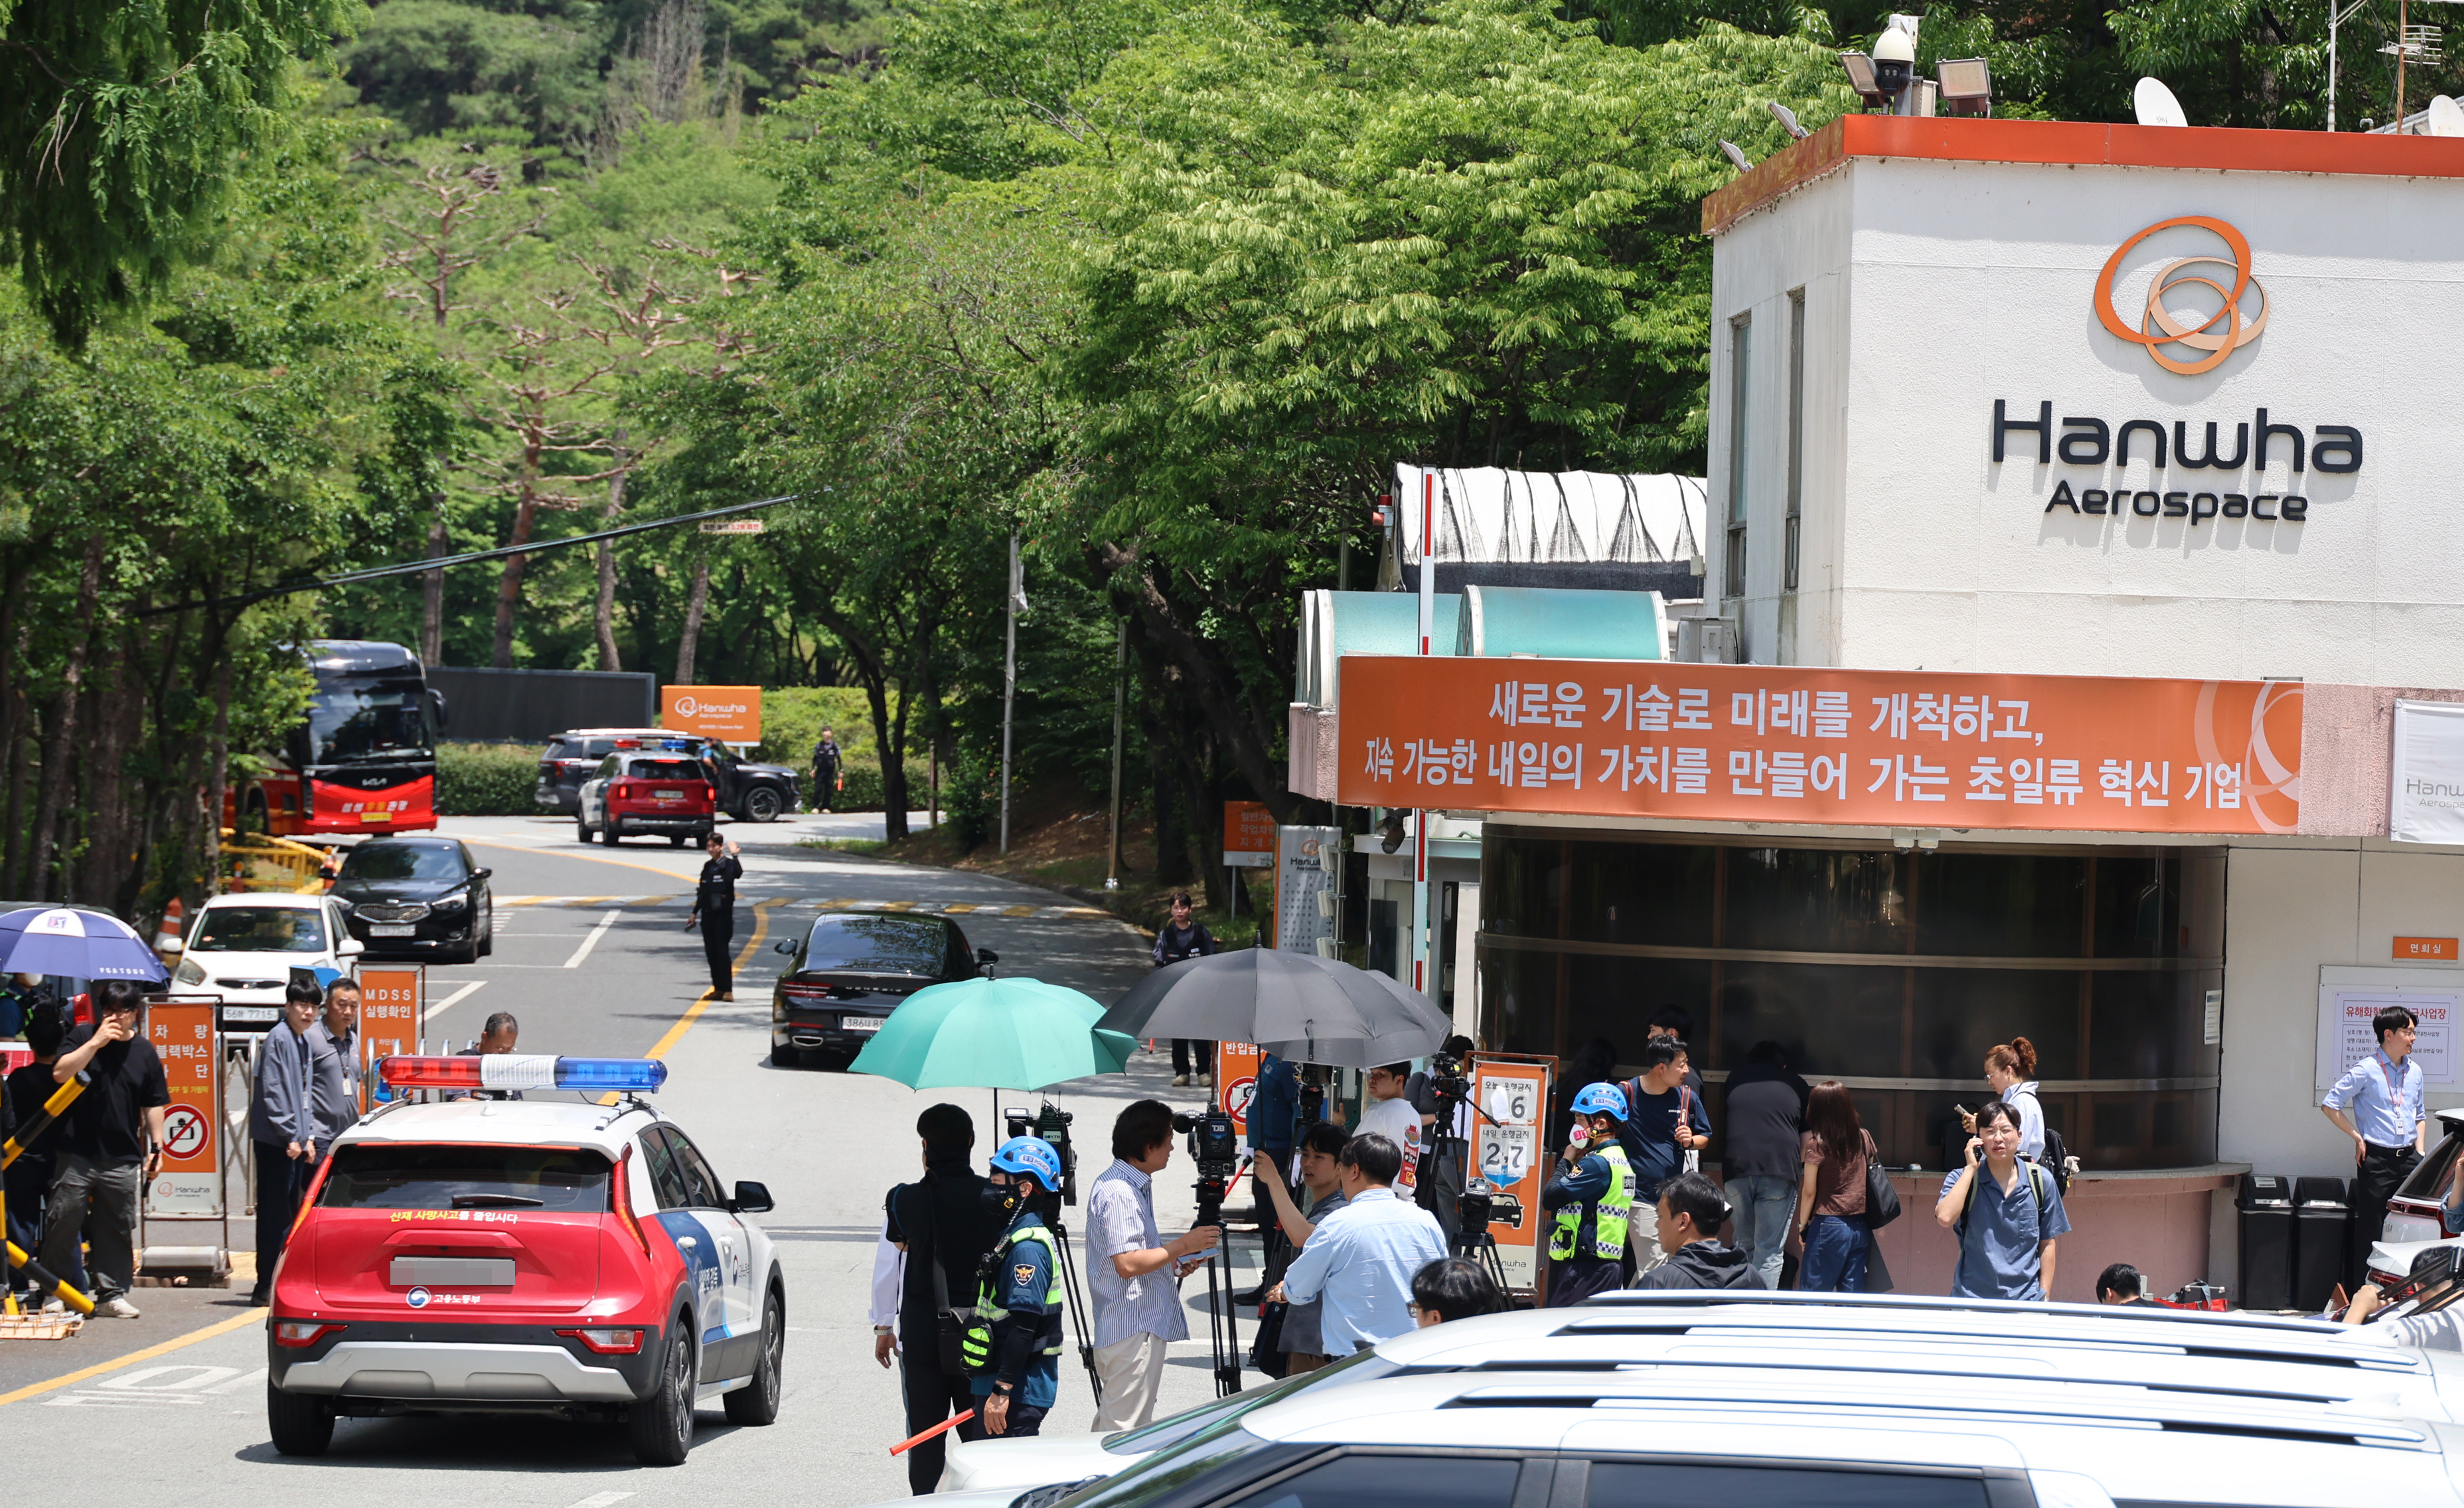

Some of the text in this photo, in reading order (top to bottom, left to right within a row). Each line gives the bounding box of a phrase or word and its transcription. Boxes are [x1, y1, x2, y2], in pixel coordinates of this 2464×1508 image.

[1993, 399, 2363, 473] Hanwha
[2045, 481, 2308, 526] Aerospace
[698, 704, 747, 713] Hanwha
[1488, 680, 2044, 747] 새로운 기술로 미래를 개척하고,
[1365, 737, 2241, 809] 지속 가능한 내일의 가치를 만들어 가는 초일류 혁신 기업
[2406, 779, 2464, 796] Hanw
[2419, 798, 2464, 810] Aerospa
[2410, 944, 2441, 954] 면회실
[366, 989, 411, 1000] MDSS
[365, 1006, 411, 1018] 실행확인
[2346, 1006, 2387, 1018] 유해화학
[155, 1044, 208, 1059] 블랙박스
[1503, 1082, 1531, 1092] 운행금지
[1511, 1096, 1525, 1118] 6
[1605, 1099, 1618, 1108] POLICE
[1501, 1130, 1529, 1139] 운행금지
[1034, 1159, 1049, 1172] POLICE
[390, 1211, 518, 1225] 산재 사망사고를 줄입시다
[1491, 1258, 1527, 1268] Hnwha
[433, 1294, 481, 1304] 고용노동부
